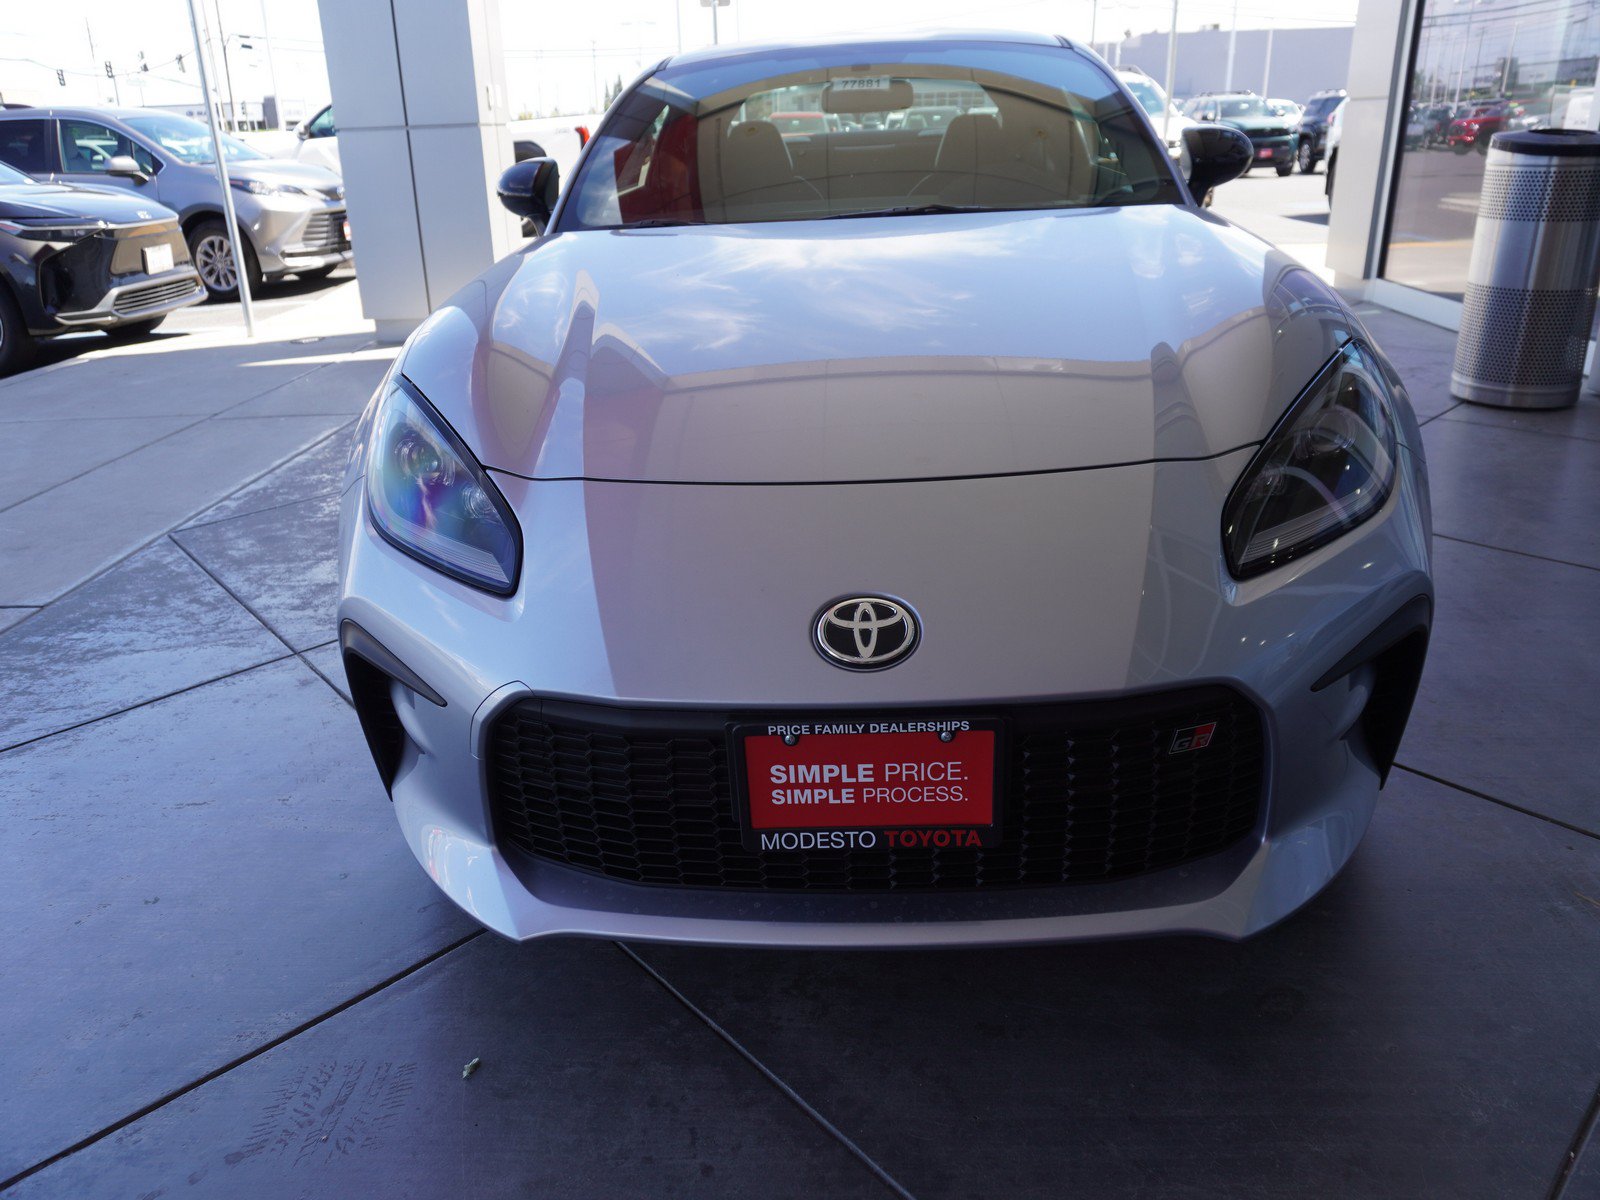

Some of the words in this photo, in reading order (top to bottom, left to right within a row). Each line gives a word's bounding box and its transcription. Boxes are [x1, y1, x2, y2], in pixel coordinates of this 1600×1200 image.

[768, 725, 810, 736] PRICE
[815, 724, 865, 735] FAMILY
[869, 721, 970, 733] DEALERSHIPS
[770, 763, 874, 784] SIMPLE
[885, 761, 968, 782] PRICE.
[771, 788, 855, 805] SIMPLE
[863, 786, 968, 803] PROCESS.
[761, 831, 876, 850] MODESTO
[884, 830, 982, 847] TOYOTA
